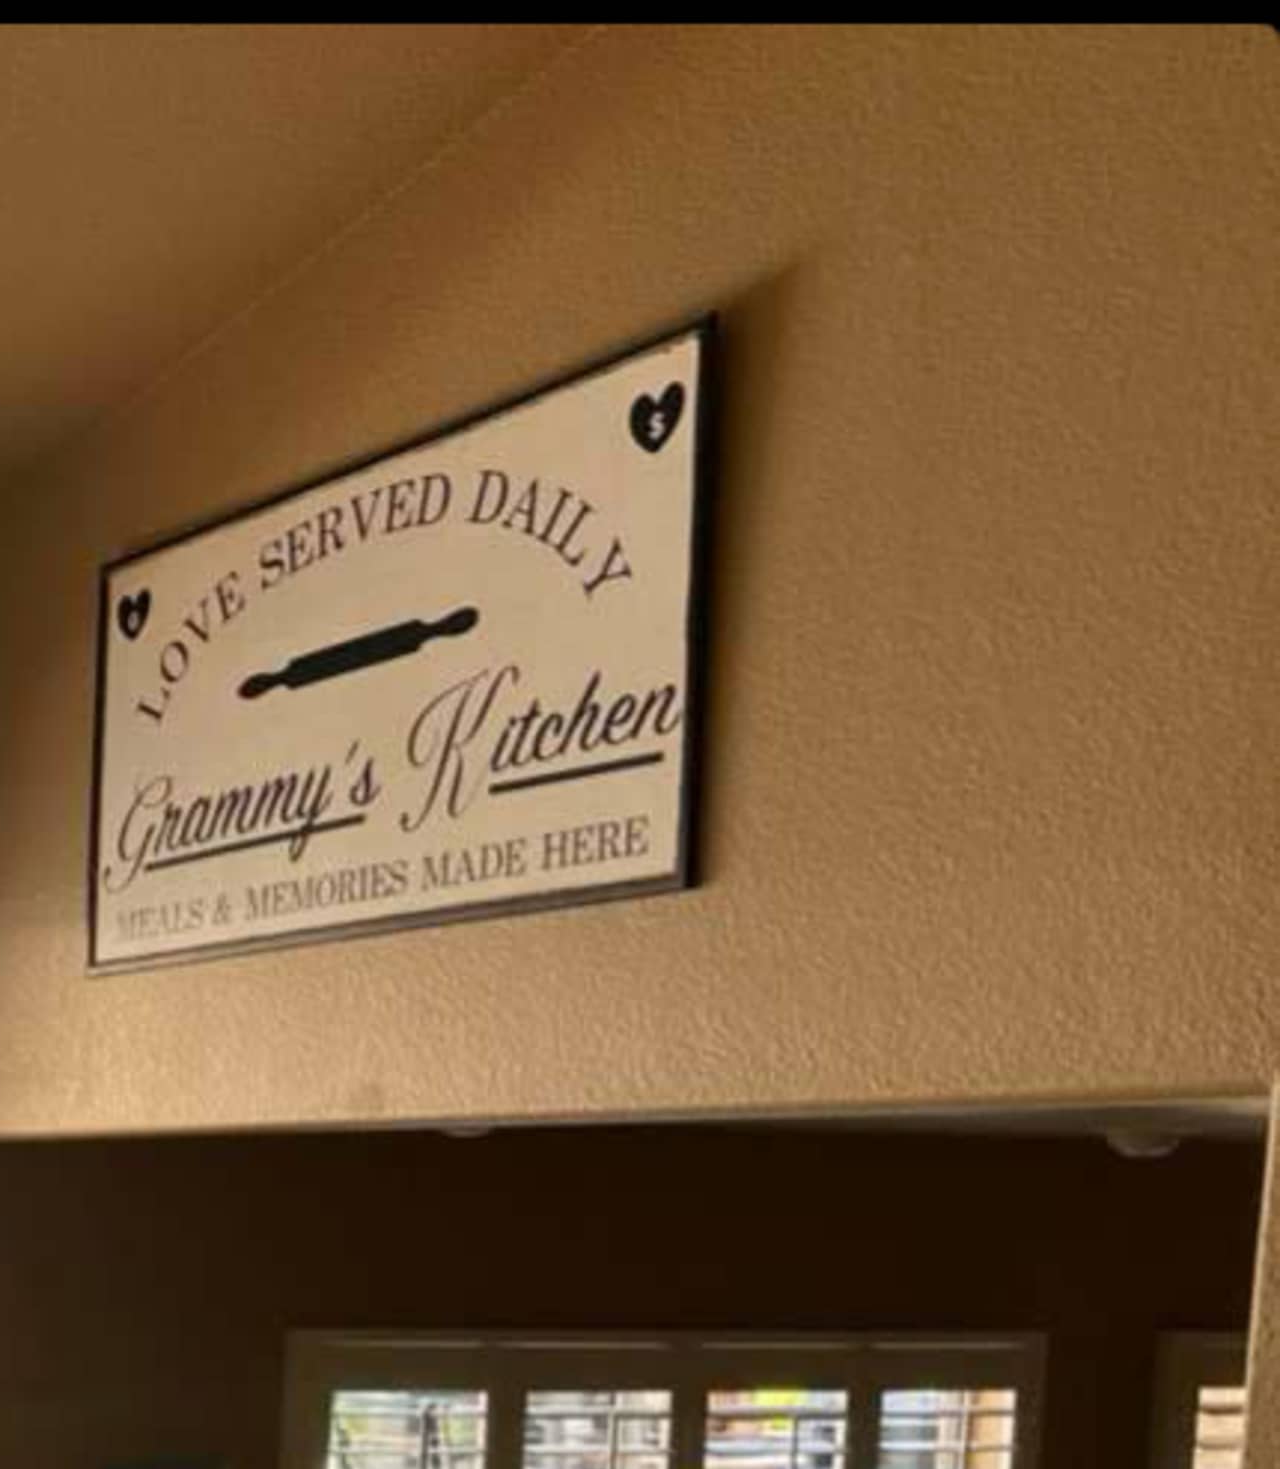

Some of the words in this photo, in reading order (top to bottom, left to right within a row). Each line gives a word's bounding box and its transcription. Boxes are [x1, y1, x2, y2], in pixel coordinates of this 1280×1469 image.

[136, 570, 247, 725] LOVE
[256, 472, 452, 591] SERVED
[465, 468, 634, 598] DAILY
[103, 741, 382, 893] Grammy's
[399, 664, 680, 833] Kitchen
[113, 895, 205, 940] MEALS
[211, 891, 233, 926] &
[243, 858, 409, 922] MEMORIES
[420, 836, 528, 892] MADE
[539, 814, 651, 873] HERE
